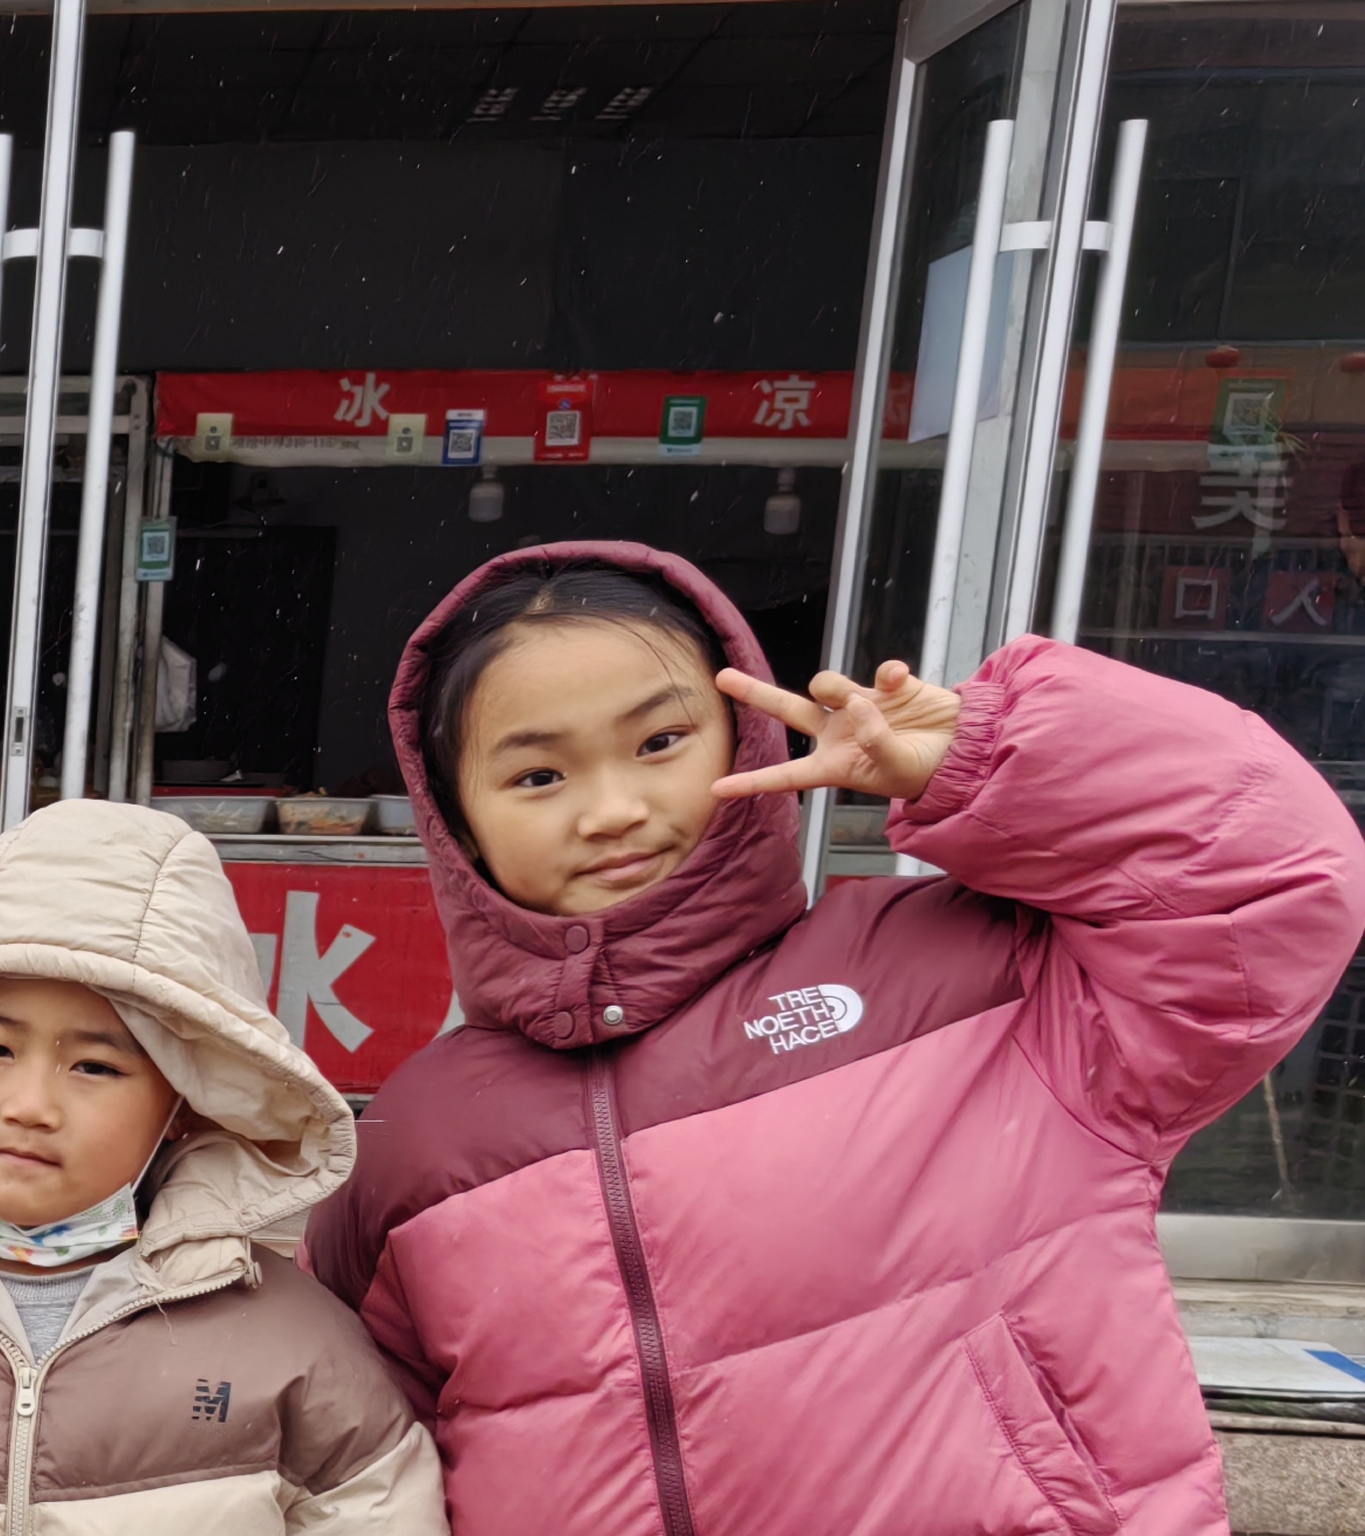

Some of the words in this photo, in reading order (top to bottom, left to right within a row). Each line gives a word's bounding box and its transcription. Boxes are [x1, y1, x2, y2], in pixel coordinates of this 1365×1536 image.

[333, 371, 391, 428] 冰
[753, 373, 817, 431] 凉
[770, 1020, 839, 1054] HACE
